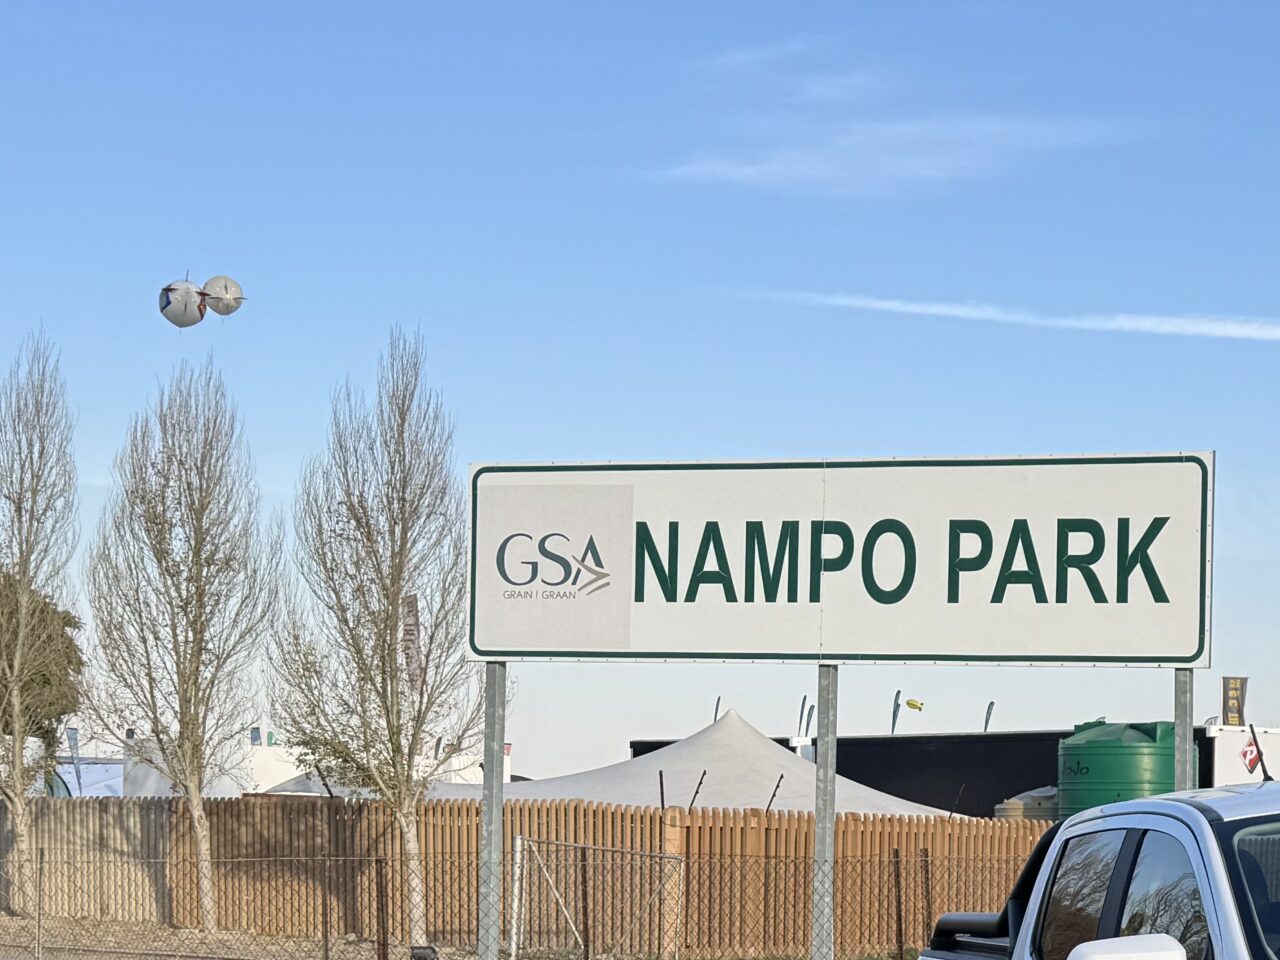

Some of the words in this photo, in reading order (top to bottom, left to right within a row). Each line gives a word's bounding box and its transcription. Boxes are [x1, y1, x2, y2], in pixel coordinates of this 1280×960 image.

[496, 532, 605, 586] GSA
[634, 518, 917, 605] NAMPO
[947, 516, 1171, 604] PARK
[503, 590, 533, 600] GRAIN
[541, 590, 576, 600] GRAAN
